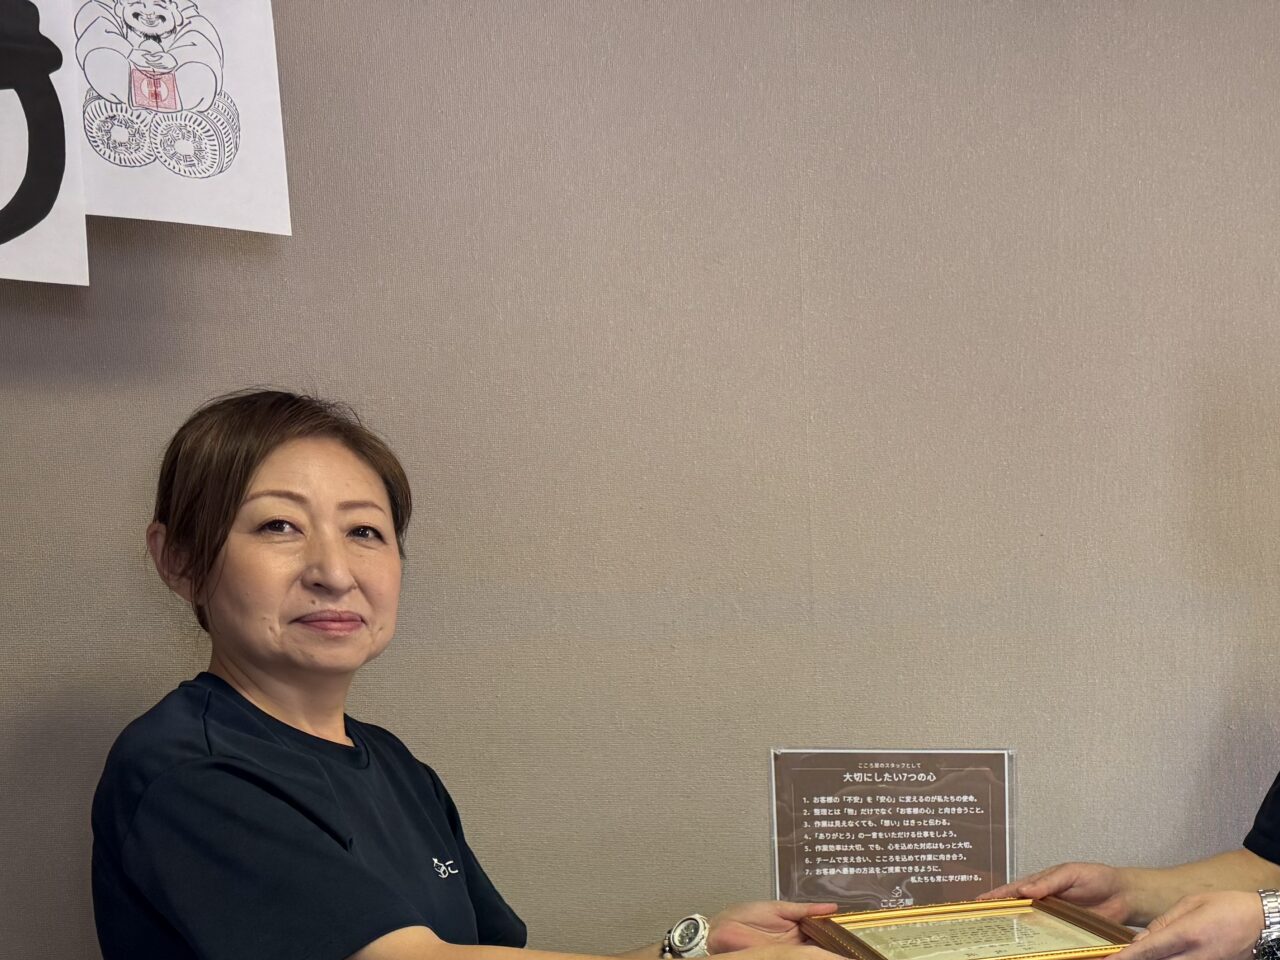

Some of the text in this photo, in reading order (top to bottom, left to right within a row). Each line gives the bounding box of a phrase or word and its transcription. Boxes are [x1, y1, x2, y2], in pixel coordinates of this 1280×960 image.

[843, 772, 936, 782] 大切にしたい7つの心
